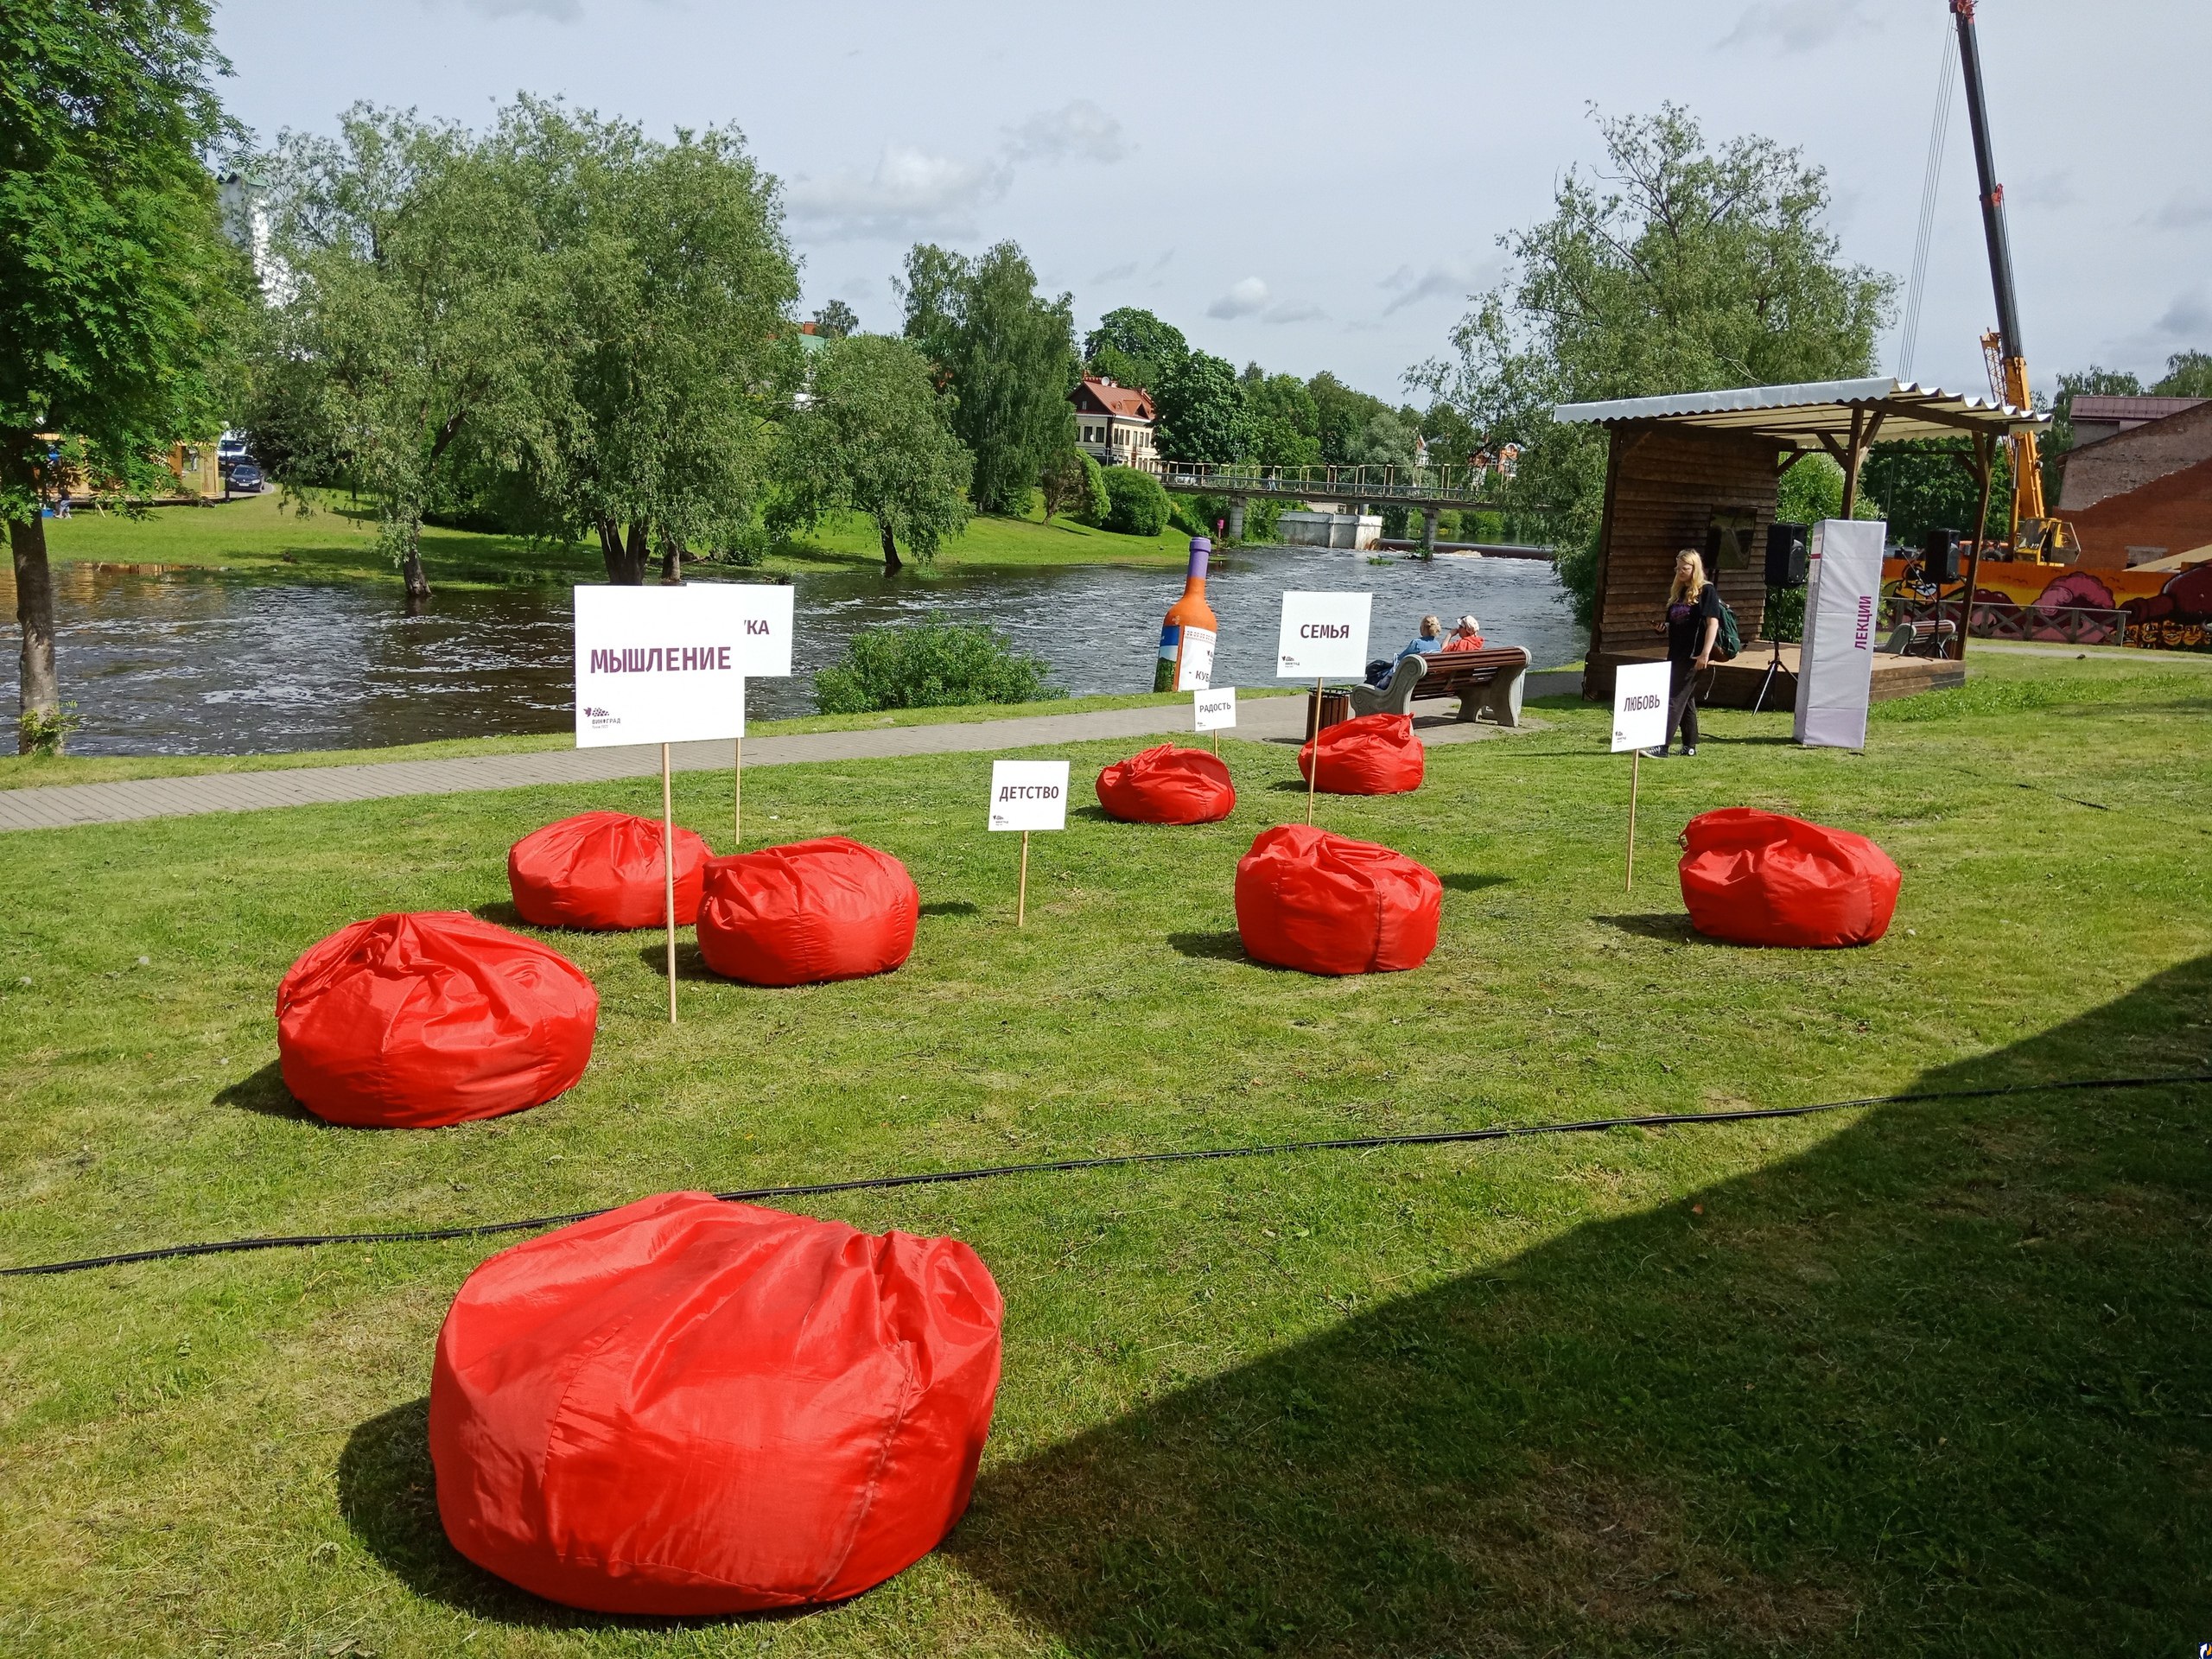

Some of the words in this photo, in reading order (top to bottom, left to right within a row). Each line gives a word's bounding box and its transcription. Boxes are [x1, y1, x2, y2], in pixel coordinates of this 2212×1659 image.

[744, 620, 770, 635] КА
[1854, 595, 1872, 650] ЛЕКЦИИ
[1300, 624, 1350, 639] СЕМЬЯ
[590, 646, 731, 673] МЫШЛЕНИЕ
[1199, 702, 1231, 714] РАДОСТЬ
[1624, 695, 1660, 712] ЛЮБОВЬ
[999, 786, 1059, 802] ДЕТСТВО
